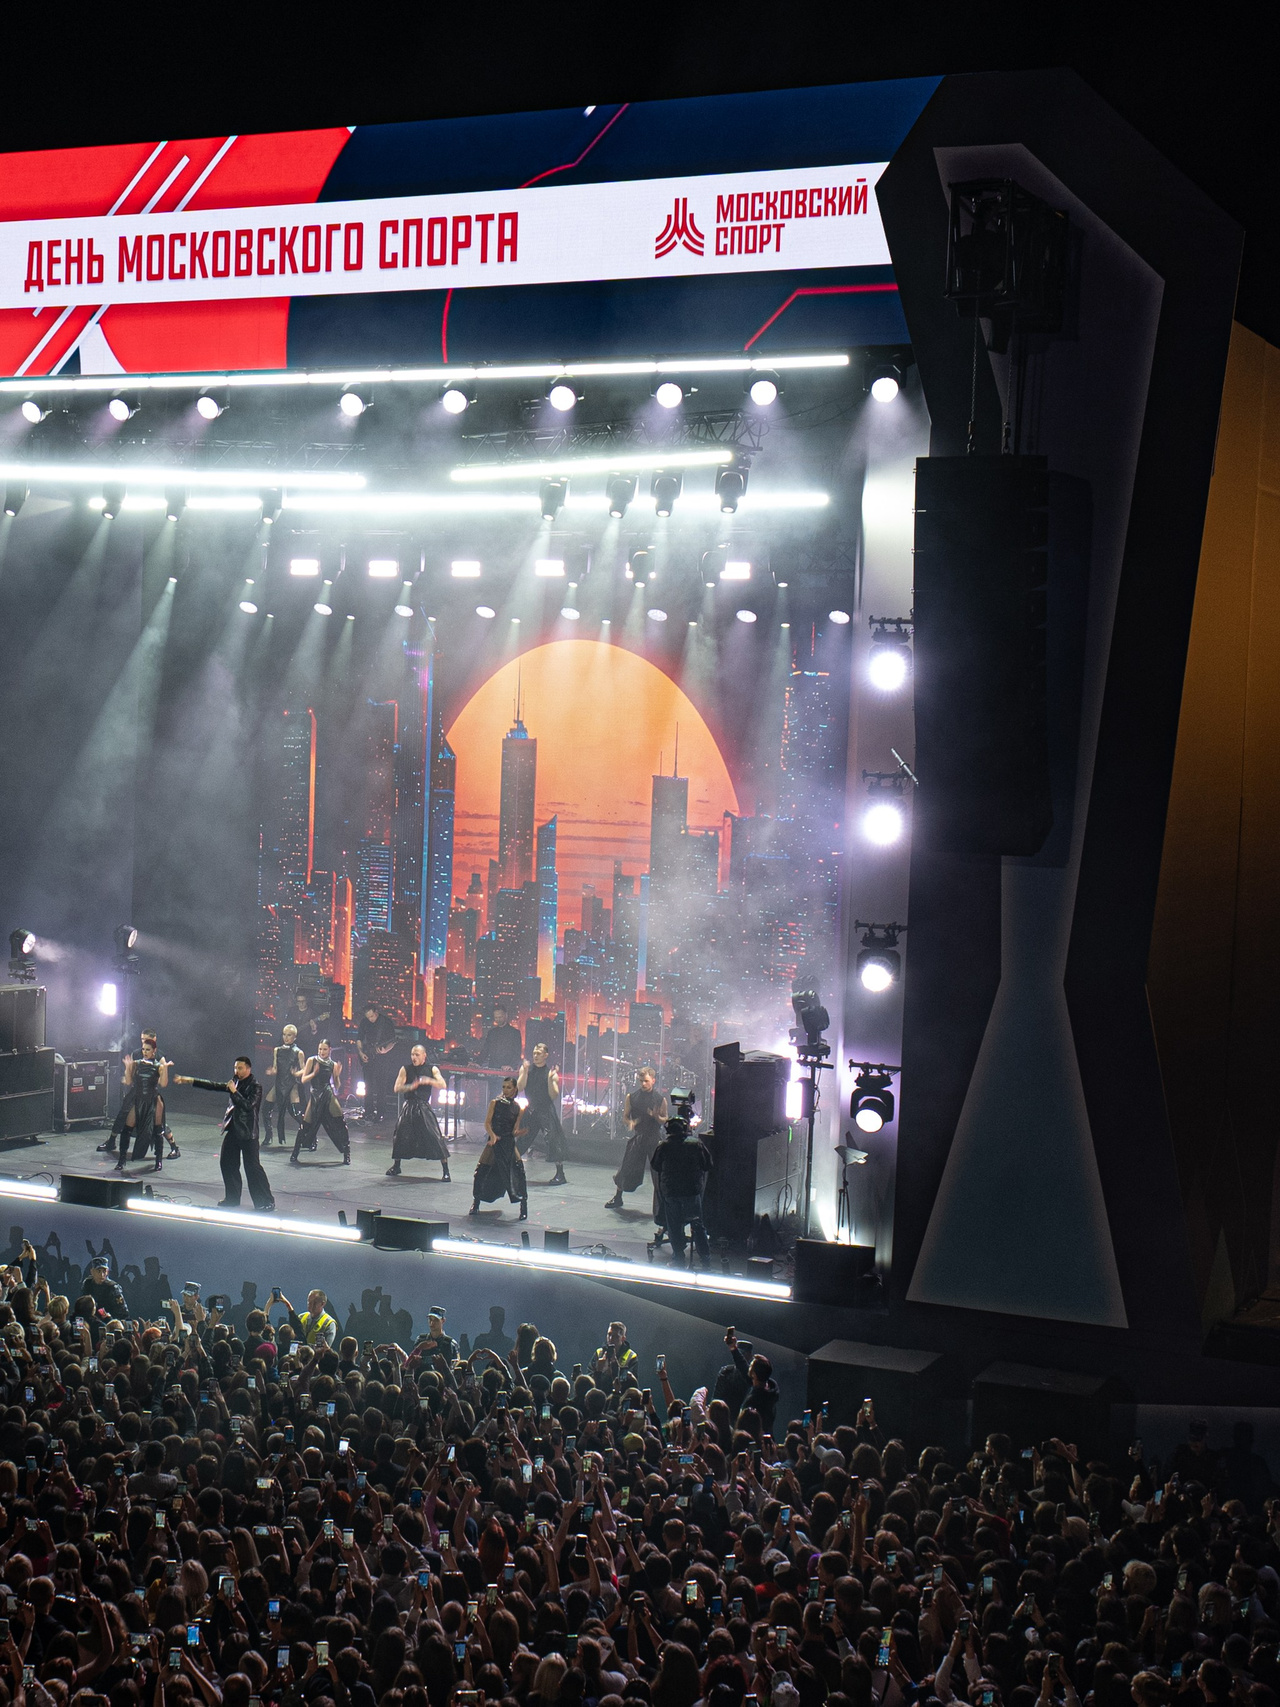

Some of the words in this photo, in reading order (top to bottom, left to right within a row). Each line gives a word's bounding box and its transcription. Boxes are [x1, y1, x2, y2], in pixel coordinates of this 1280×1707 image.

[715, 178, 869, 224] МОСКОВСКИЙ
[24, 238, 104, 293] ДЕНЬ
[118, 221, 364, 283] МОСКОВСКОГО
[378, 211, 519, 270] СПОРТА
[714, 223, 786, 256] СПОРТ
